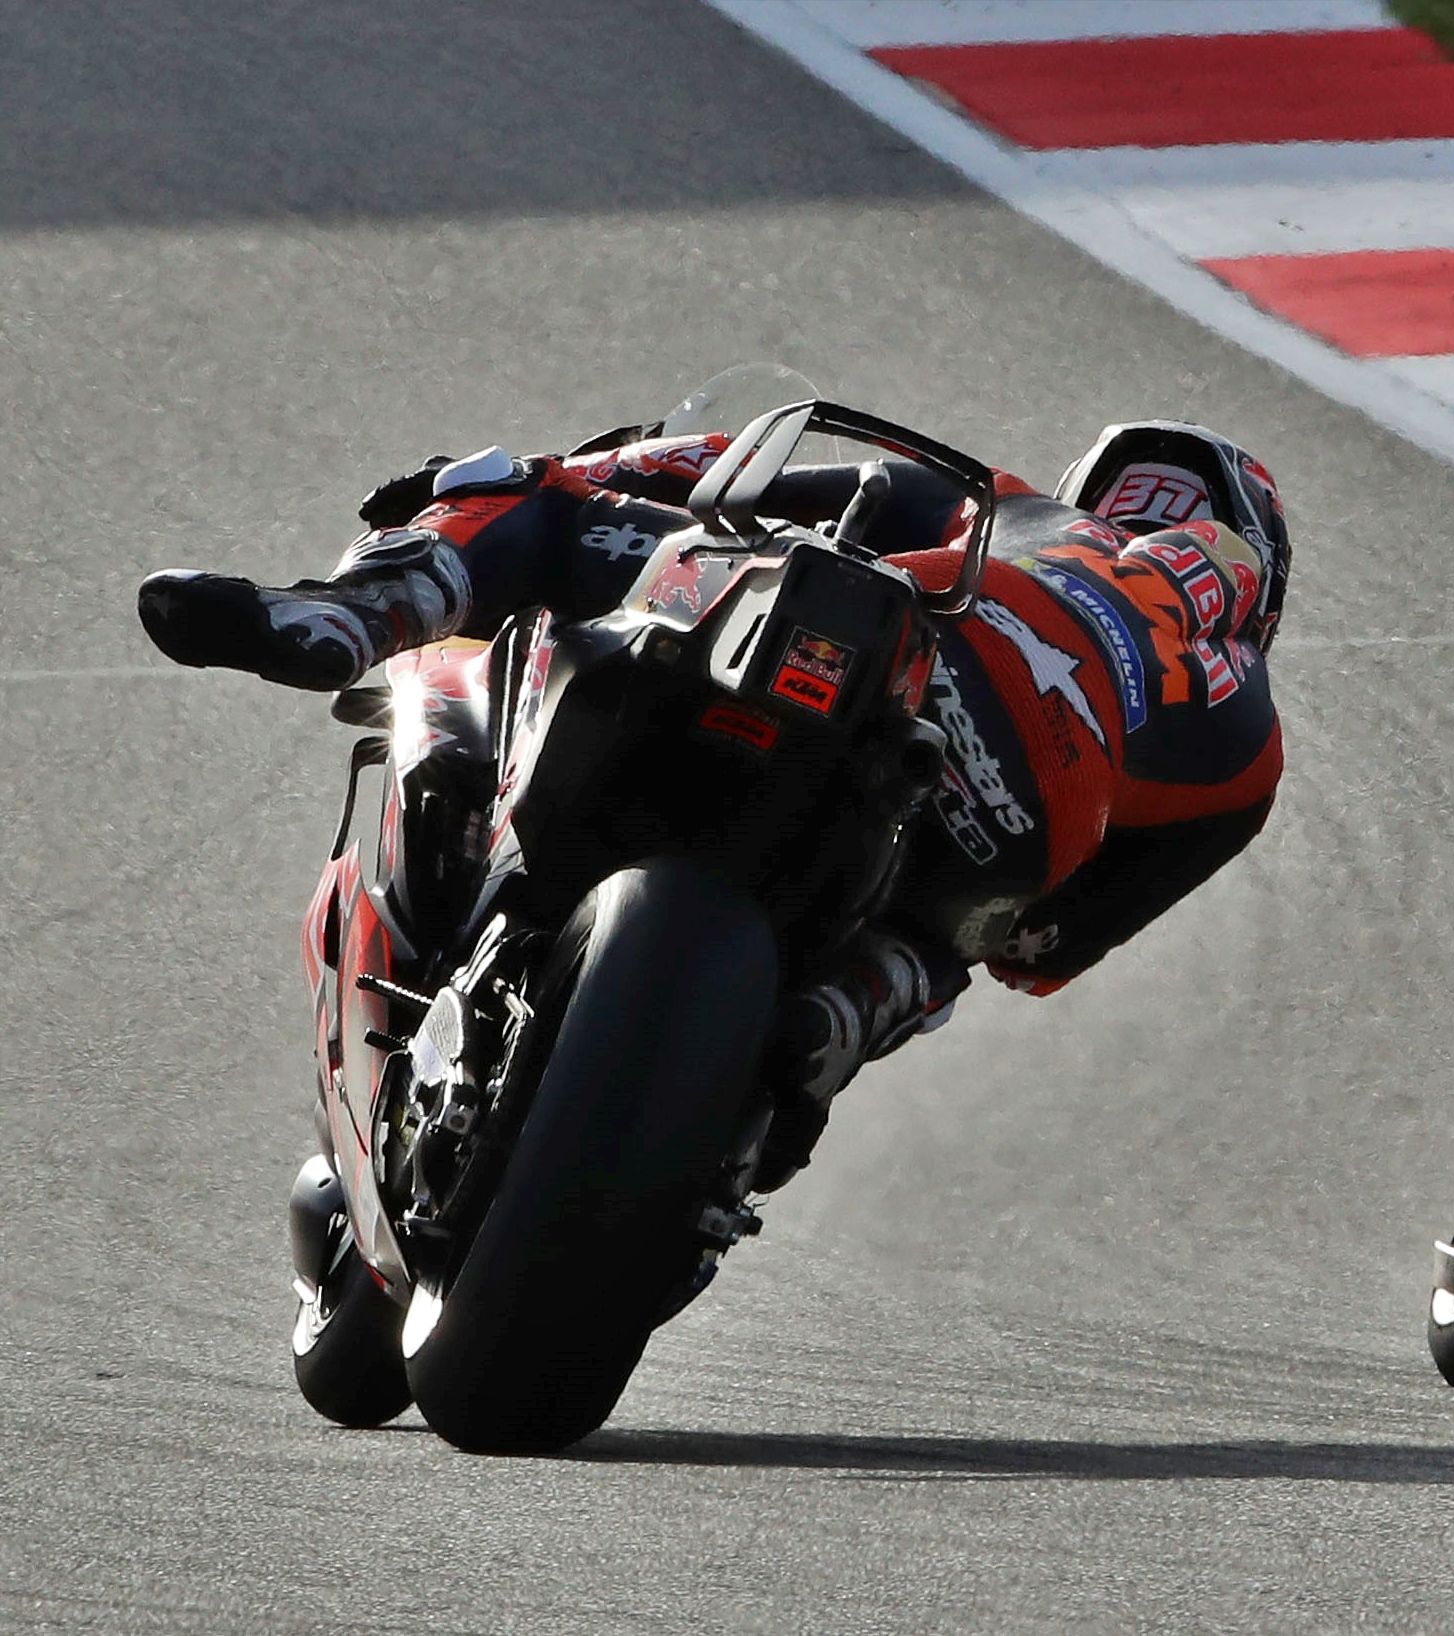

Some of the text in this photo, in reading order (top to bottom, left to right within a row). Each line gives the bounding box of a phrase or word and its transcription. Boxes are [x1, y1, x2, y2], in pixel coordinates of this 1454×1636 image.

[1106, 473, 1208, 524] 37
[1071, 588, 1140, 708] MICHELIN
[1182, 568, 1240, 709] Bull
